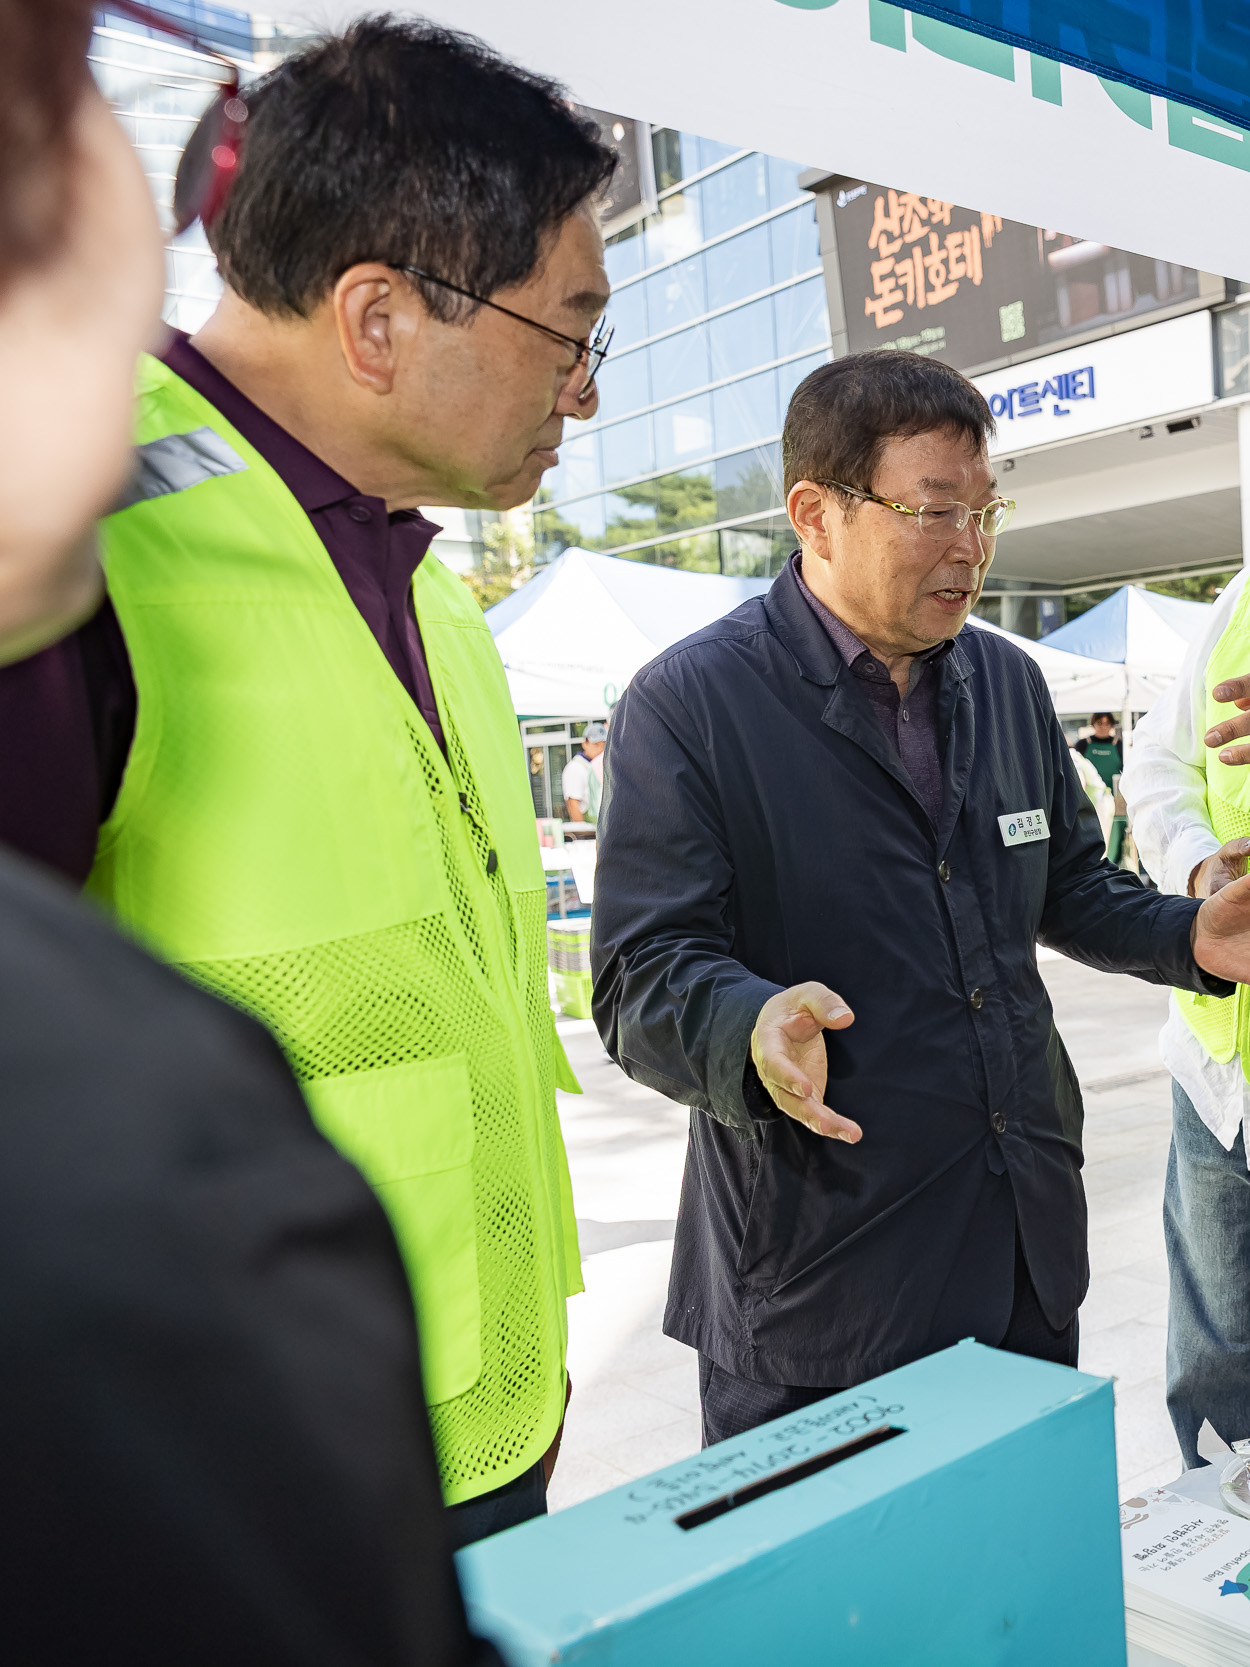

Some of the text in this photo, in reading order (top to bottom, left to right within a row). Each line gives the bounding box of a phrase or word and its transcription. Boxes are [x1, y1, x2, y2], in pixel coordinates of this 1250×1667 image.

[864, 224, 983, 329] 돈키호테
[1131, 1518, 1204, 1562] 사단법인 희망벨
[1180, 1533, 1206, 1548] 세상을
[1157, 1547, 1183, 1563] 만들어
[1138, 1562, 1158, 1573] 가는
[1160, 1556, 1186, 1572] 더불어
[1202, 1569, 1224, 1583] Bell
